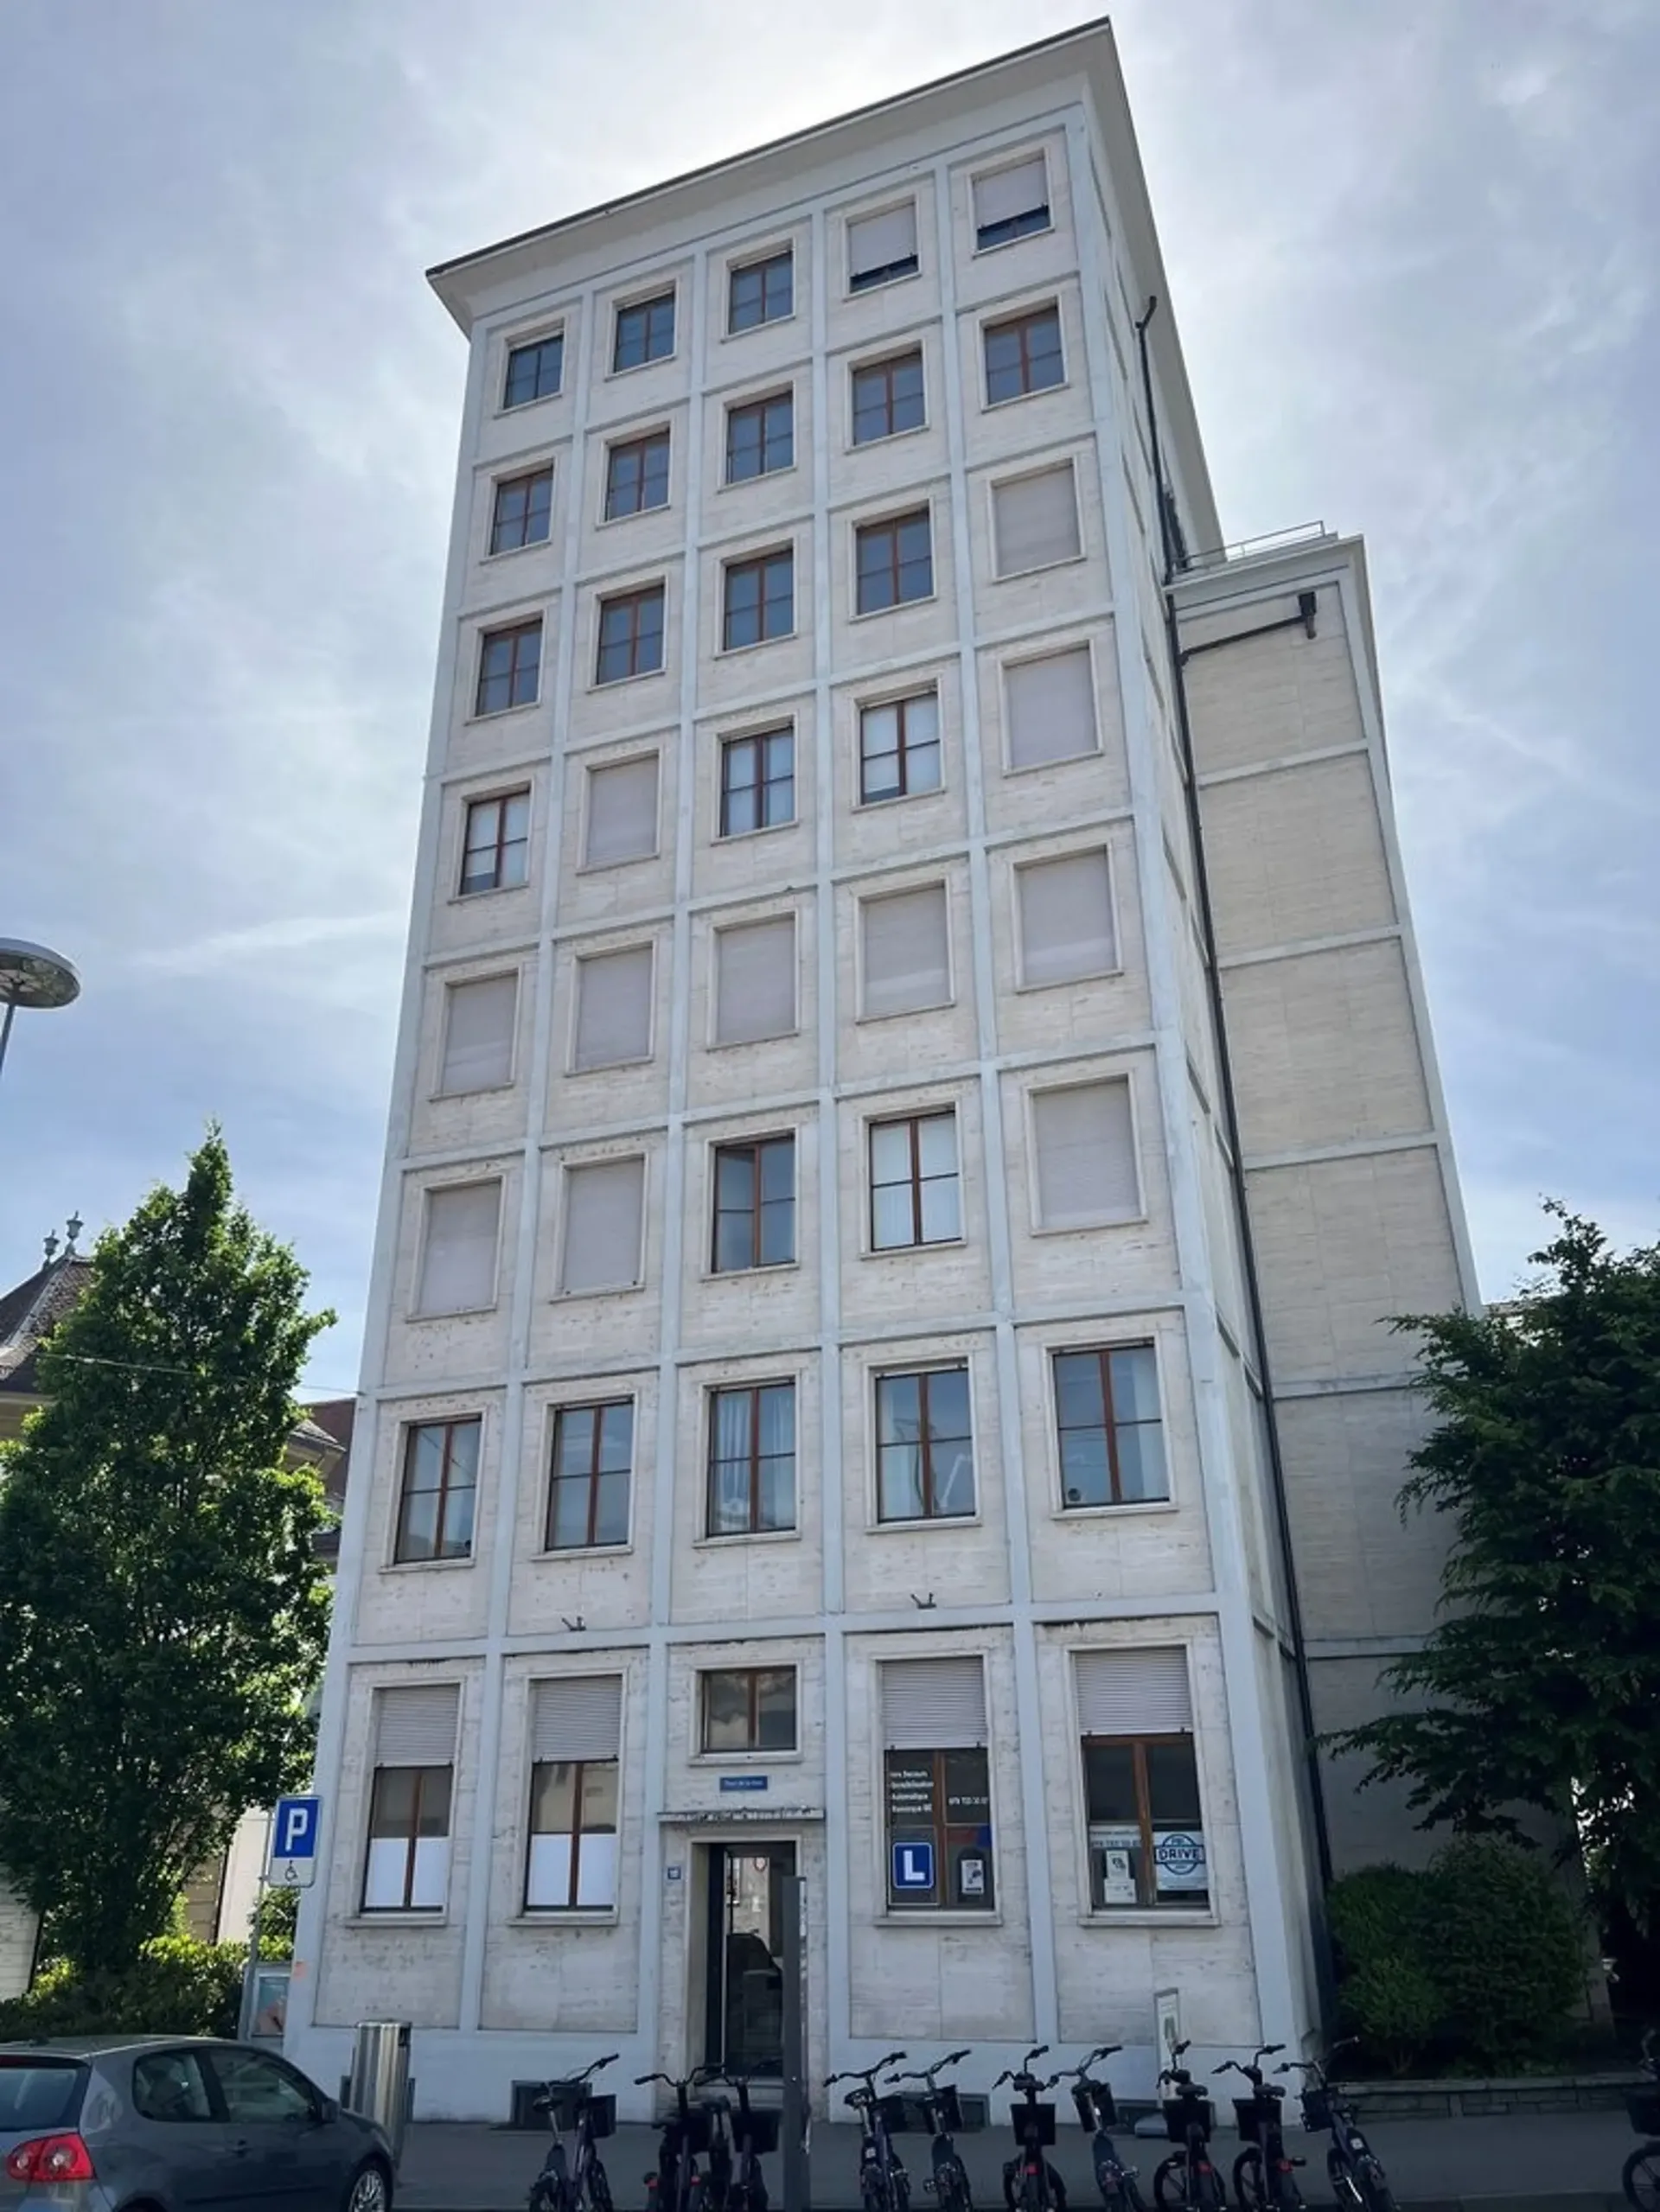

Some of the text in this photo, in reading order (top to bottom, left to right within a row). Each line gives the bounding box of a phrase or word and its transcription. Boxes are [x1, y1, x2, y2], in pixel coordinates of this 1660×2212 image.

[285, 1807, 309, 1852] P
[903, 1850, 925, 1881] L
[1159, 1848, 1200, 1860] DRIVE
